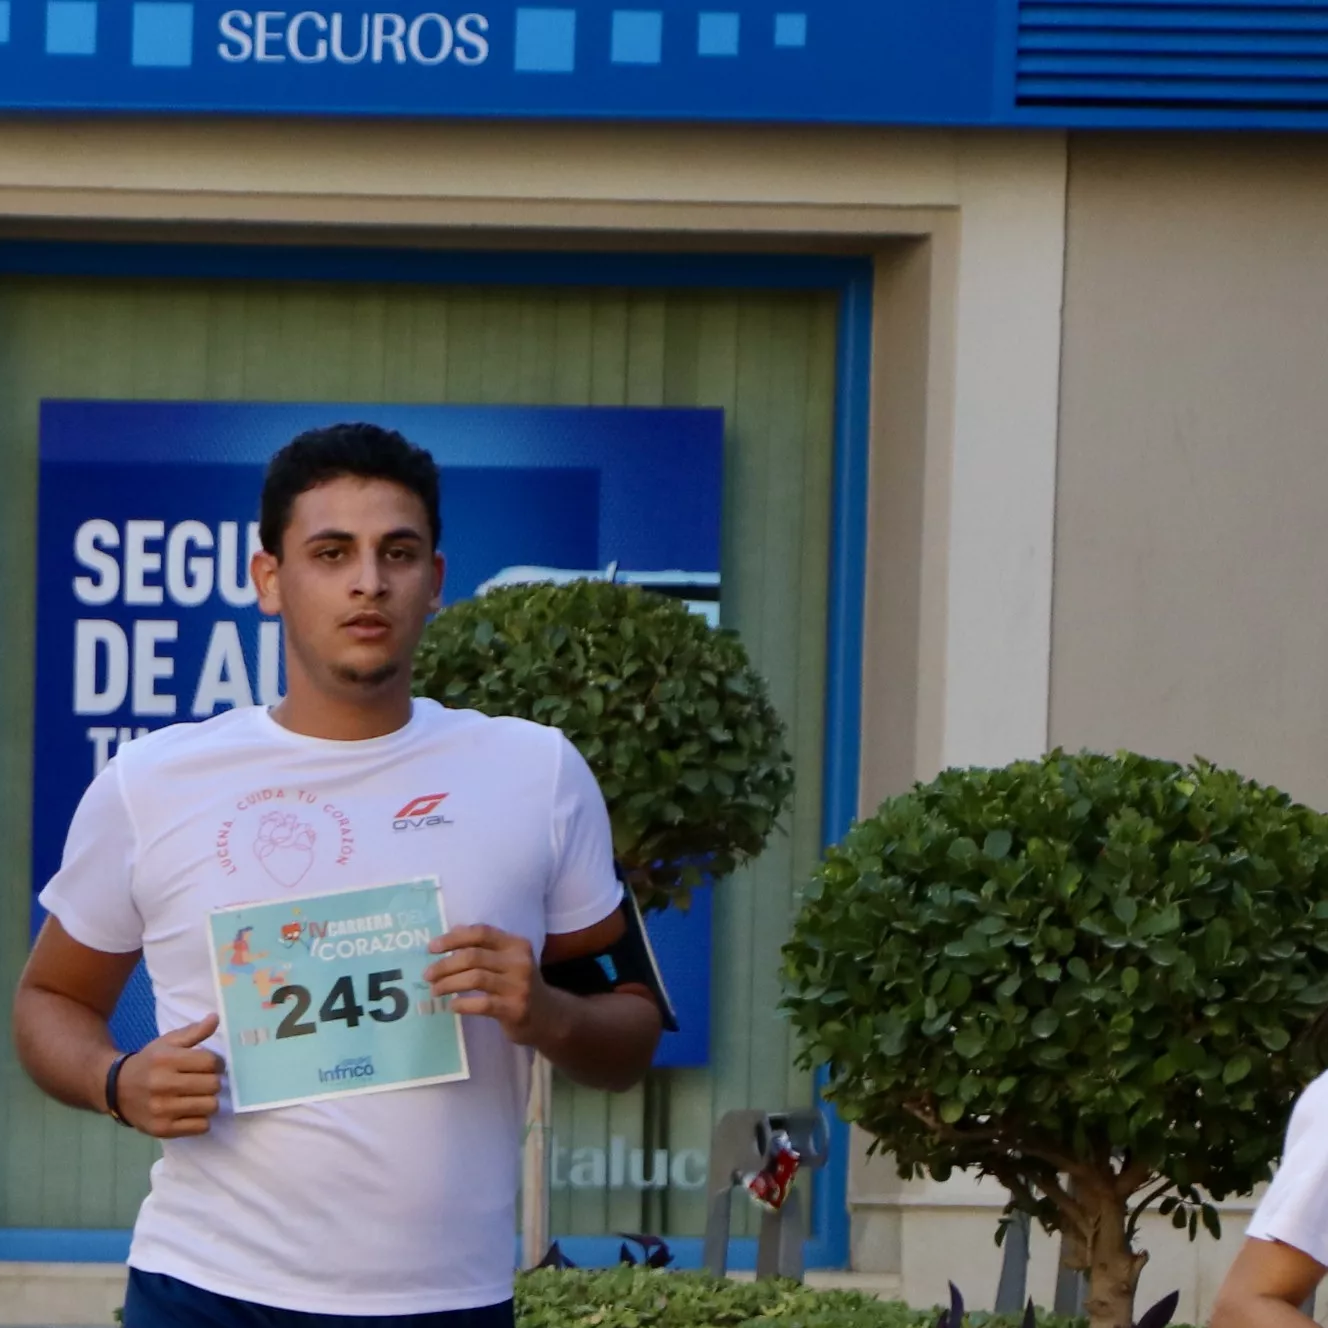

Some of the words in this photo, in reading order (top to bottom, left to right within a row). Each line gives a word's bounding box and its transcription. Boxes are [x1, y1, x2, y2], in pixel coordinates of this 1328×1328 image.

[218, 9, 489, 66] SEGUROS
[72, 518, 263, 608] SEGU
[73, 618, 179, 717] DE
[191, 620, 287, 716] AU
[216, 819, 237, 876] LUCENA
[237, 788, 286, 811] CUIDA
[298, 790, 317, 804] TU
[327, 913, 393, 937] CARRERA
[271, 968, 410, 1040] 245
[318, 1064, 375, 1083] Infrico
